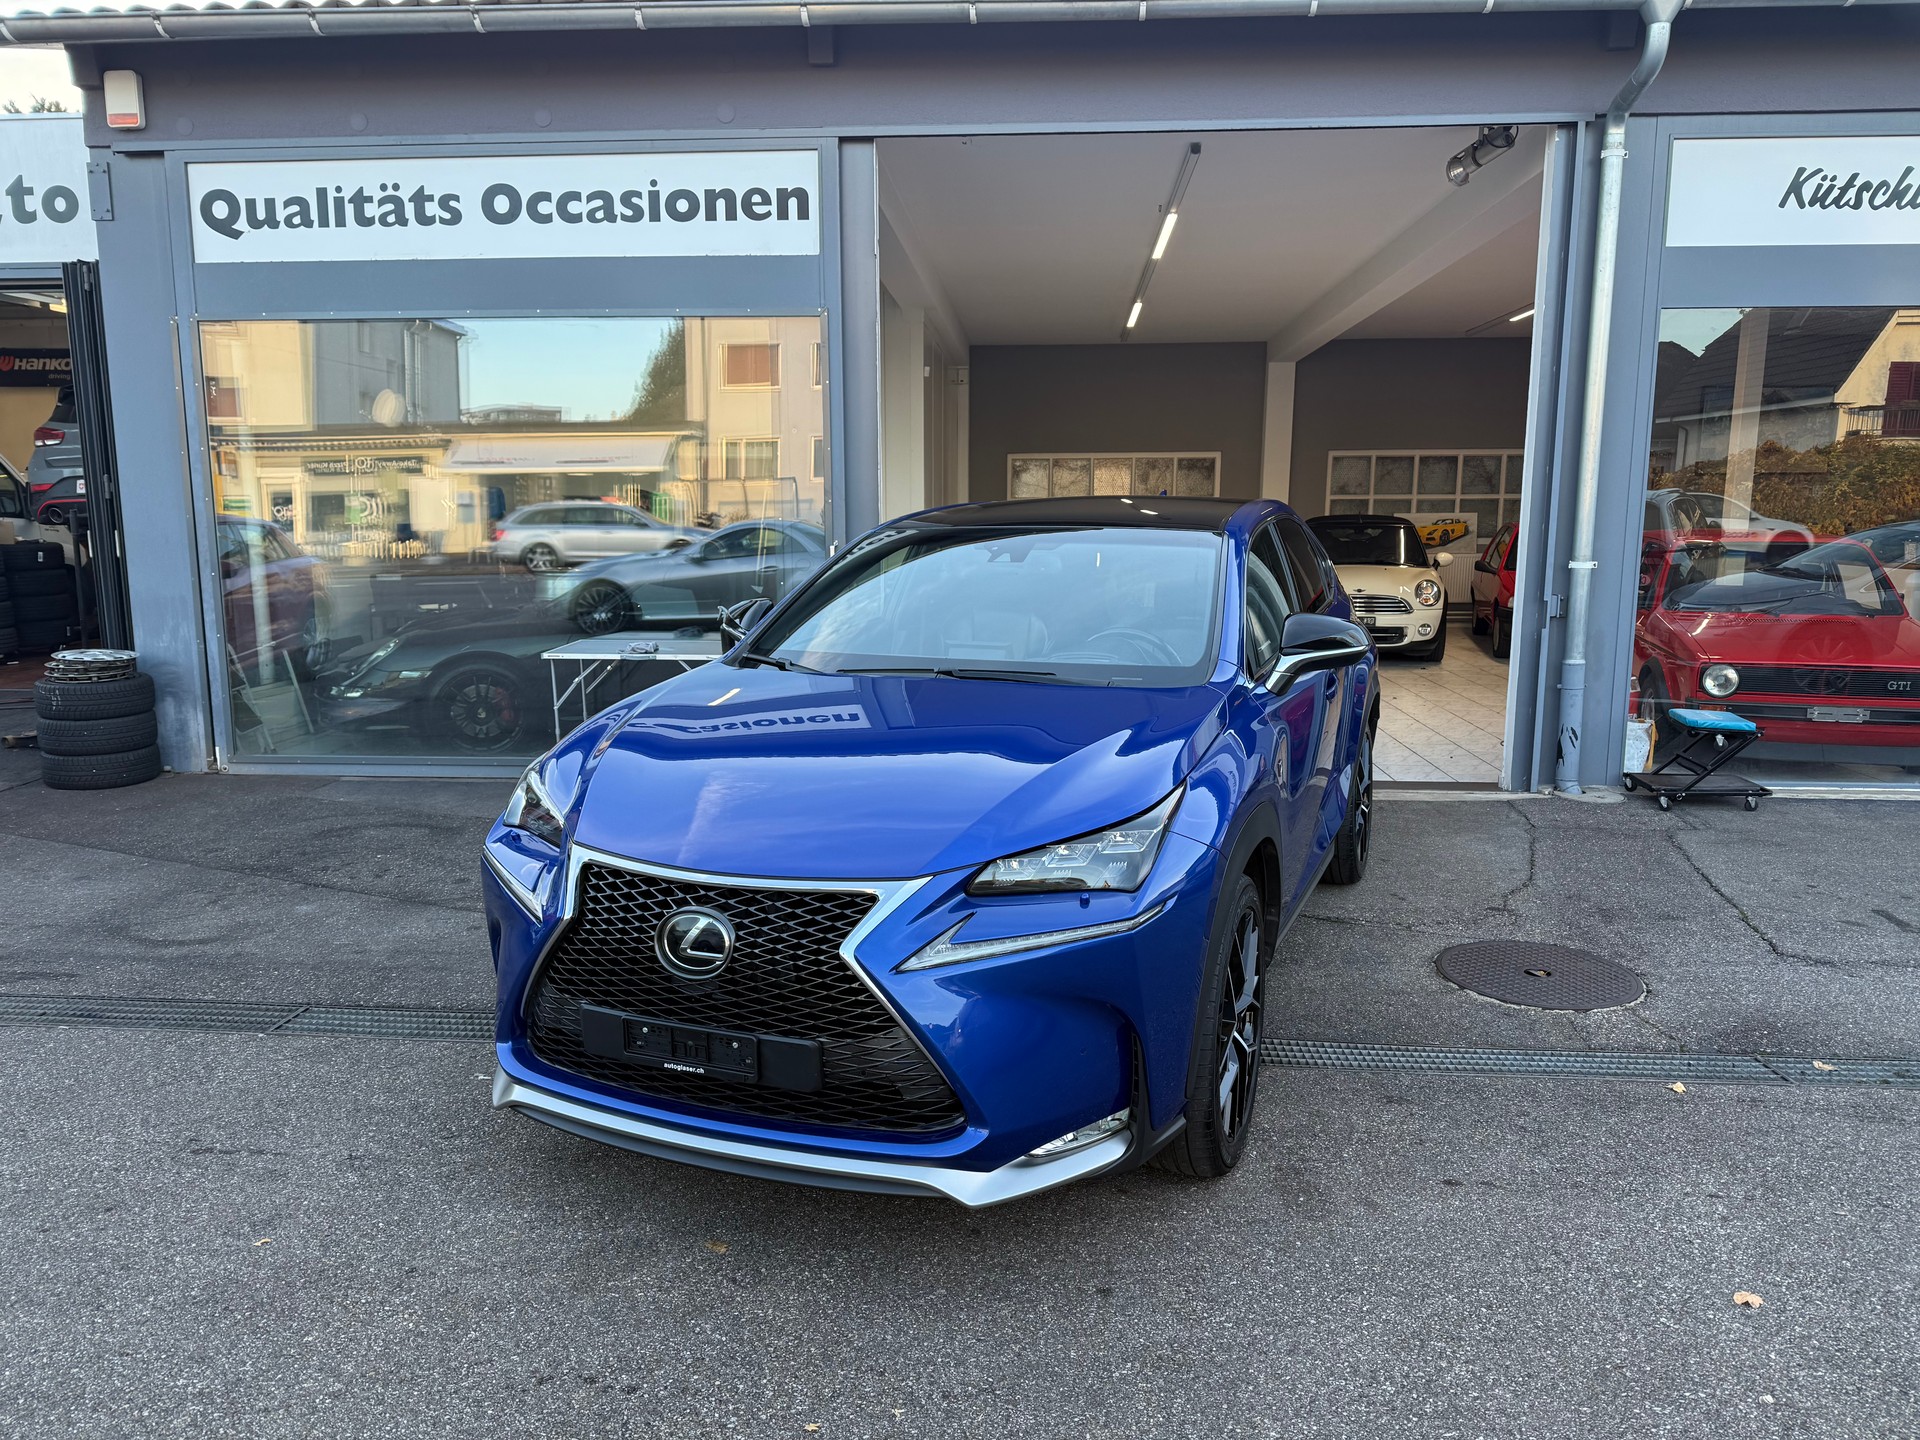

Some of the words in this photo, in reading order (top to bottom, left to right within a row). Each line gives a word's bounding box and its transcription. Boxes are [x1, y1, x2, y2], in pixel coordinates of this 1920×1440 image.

[1778, 165, 1920, 211] Kütsch
[199, 182, 463, 241] Qualitäts
[480, 178, 811, 226] Occasionen
[1887, 681, 1912, 691] GTI
[663, 1062, 705, 1074] autoglaser.ch
